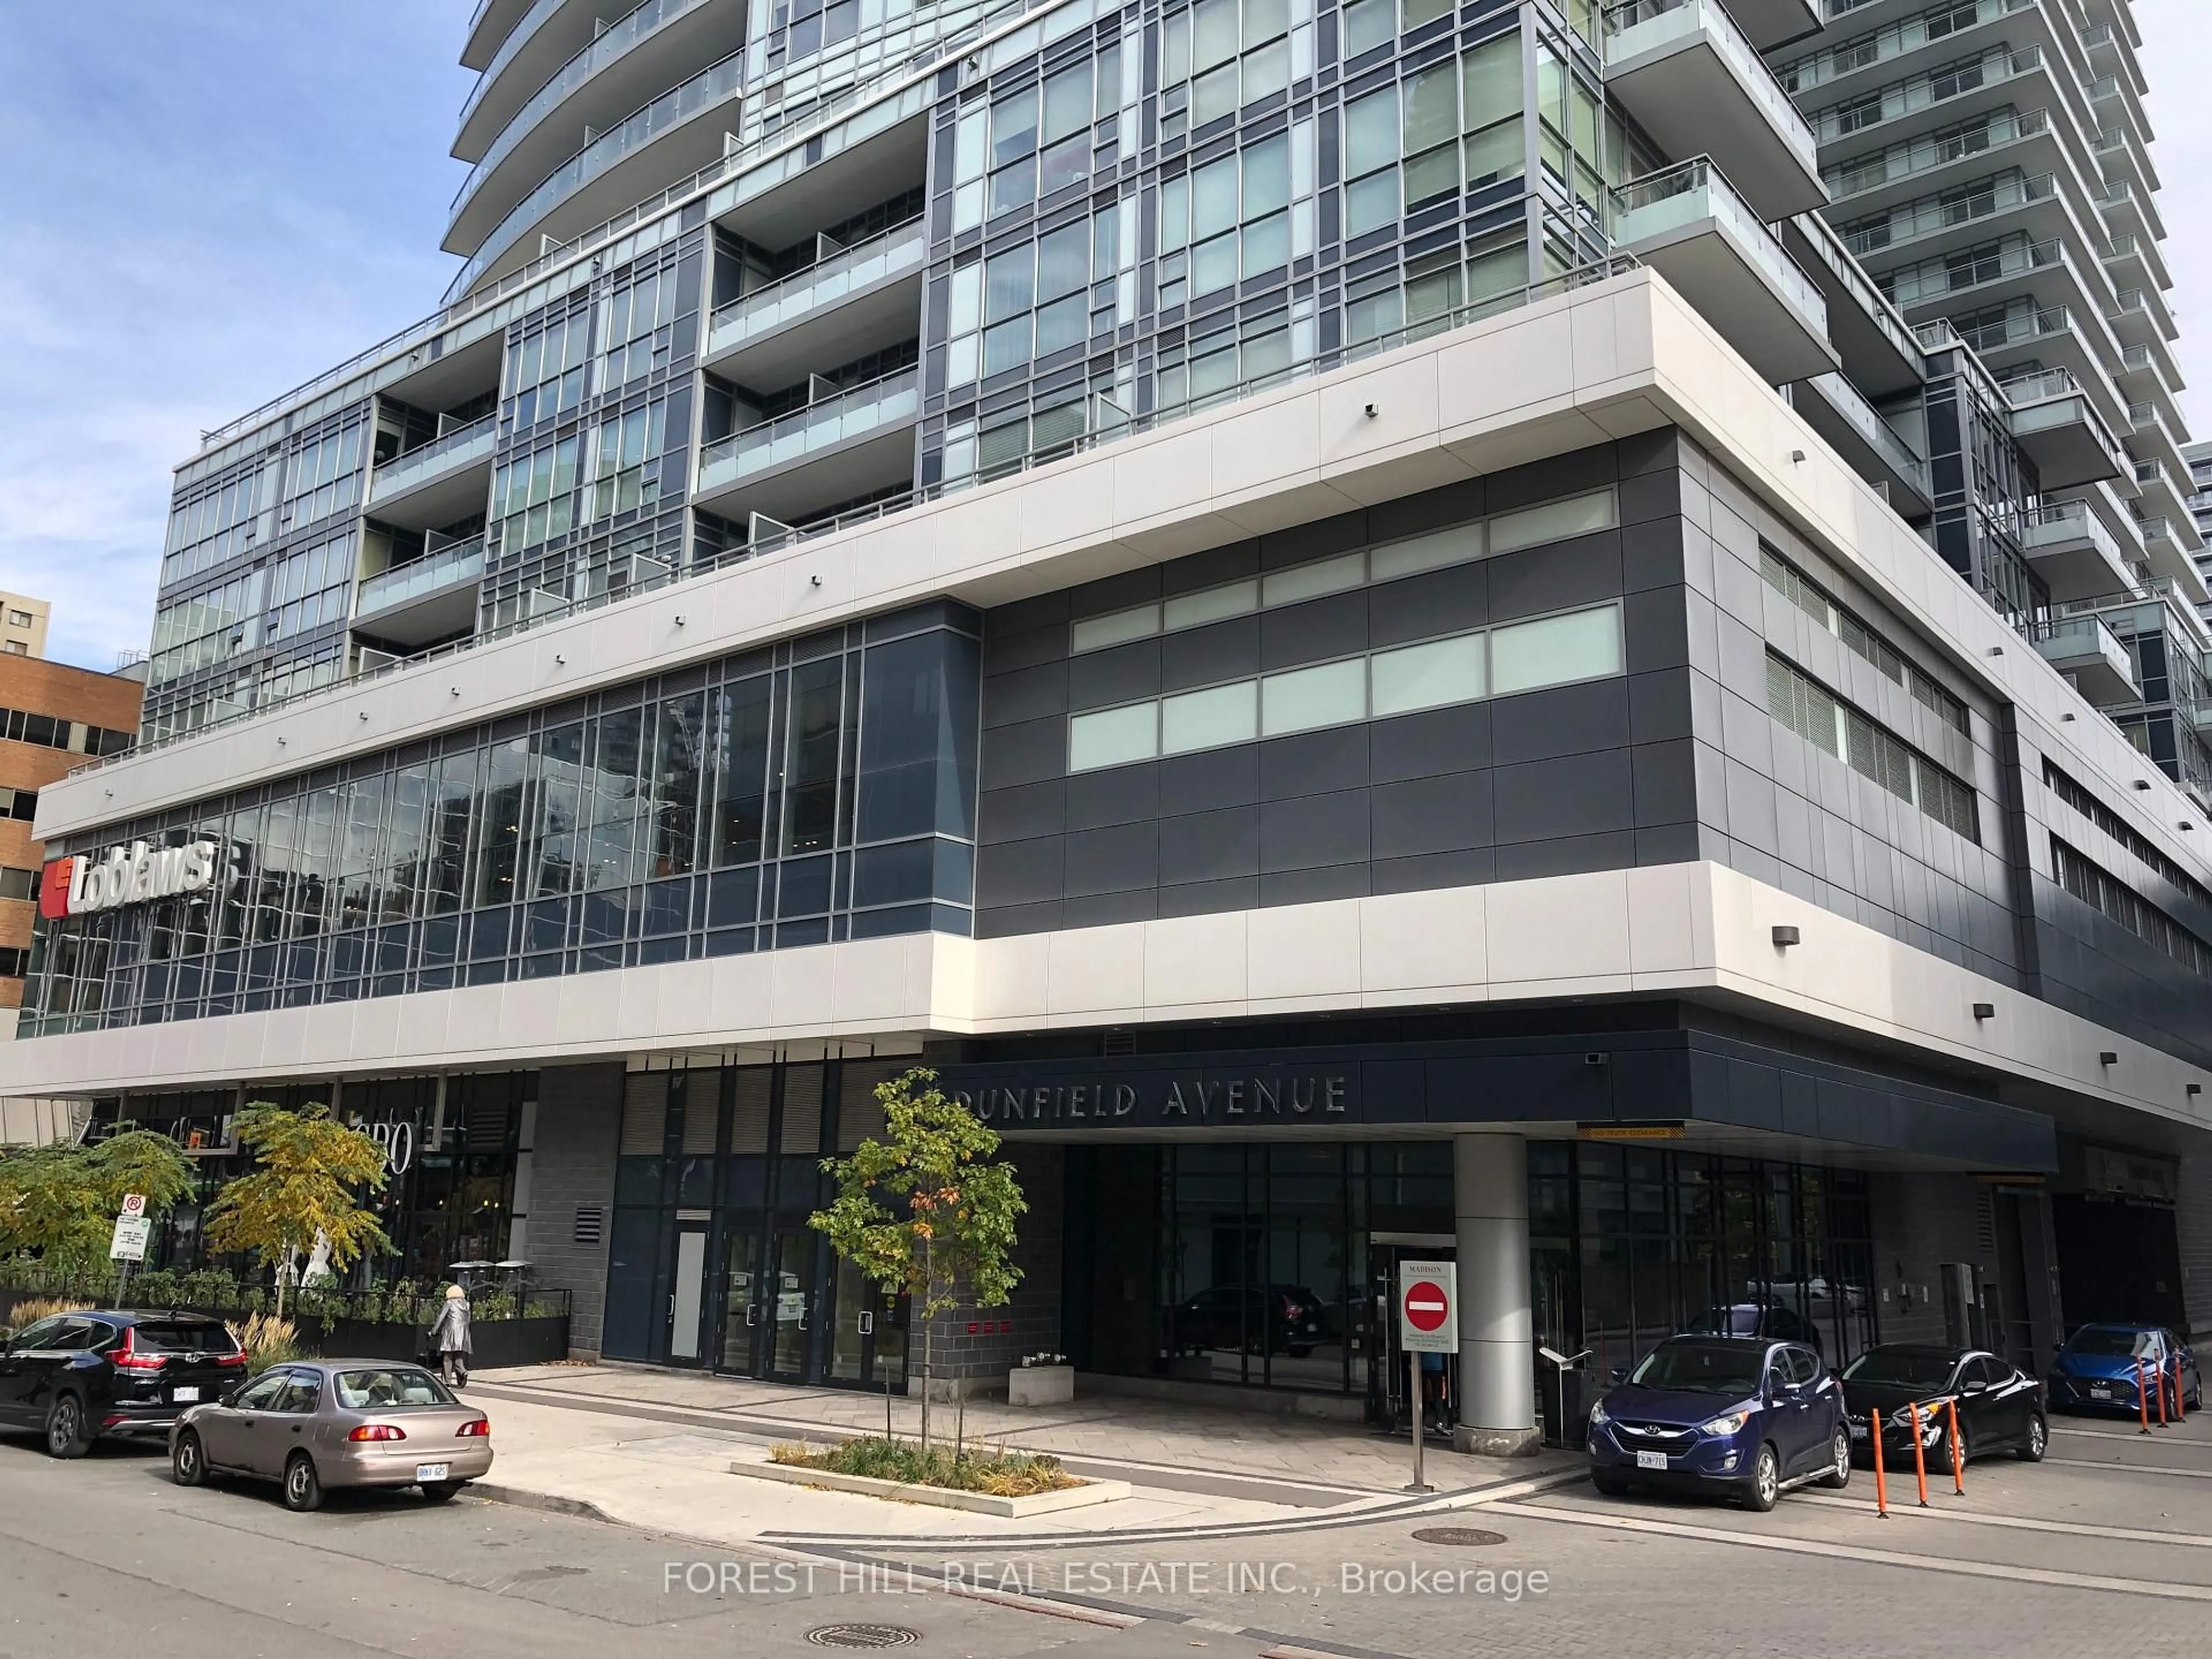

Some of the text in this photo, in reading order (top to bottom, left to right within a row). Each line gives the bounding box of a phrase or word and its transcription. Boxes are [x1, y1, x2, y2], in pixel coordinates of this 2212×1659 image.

[67, 841, 214, 914] Loblaws
[953, 1077, 1345, 1120] DUNFIELD AVENUE
